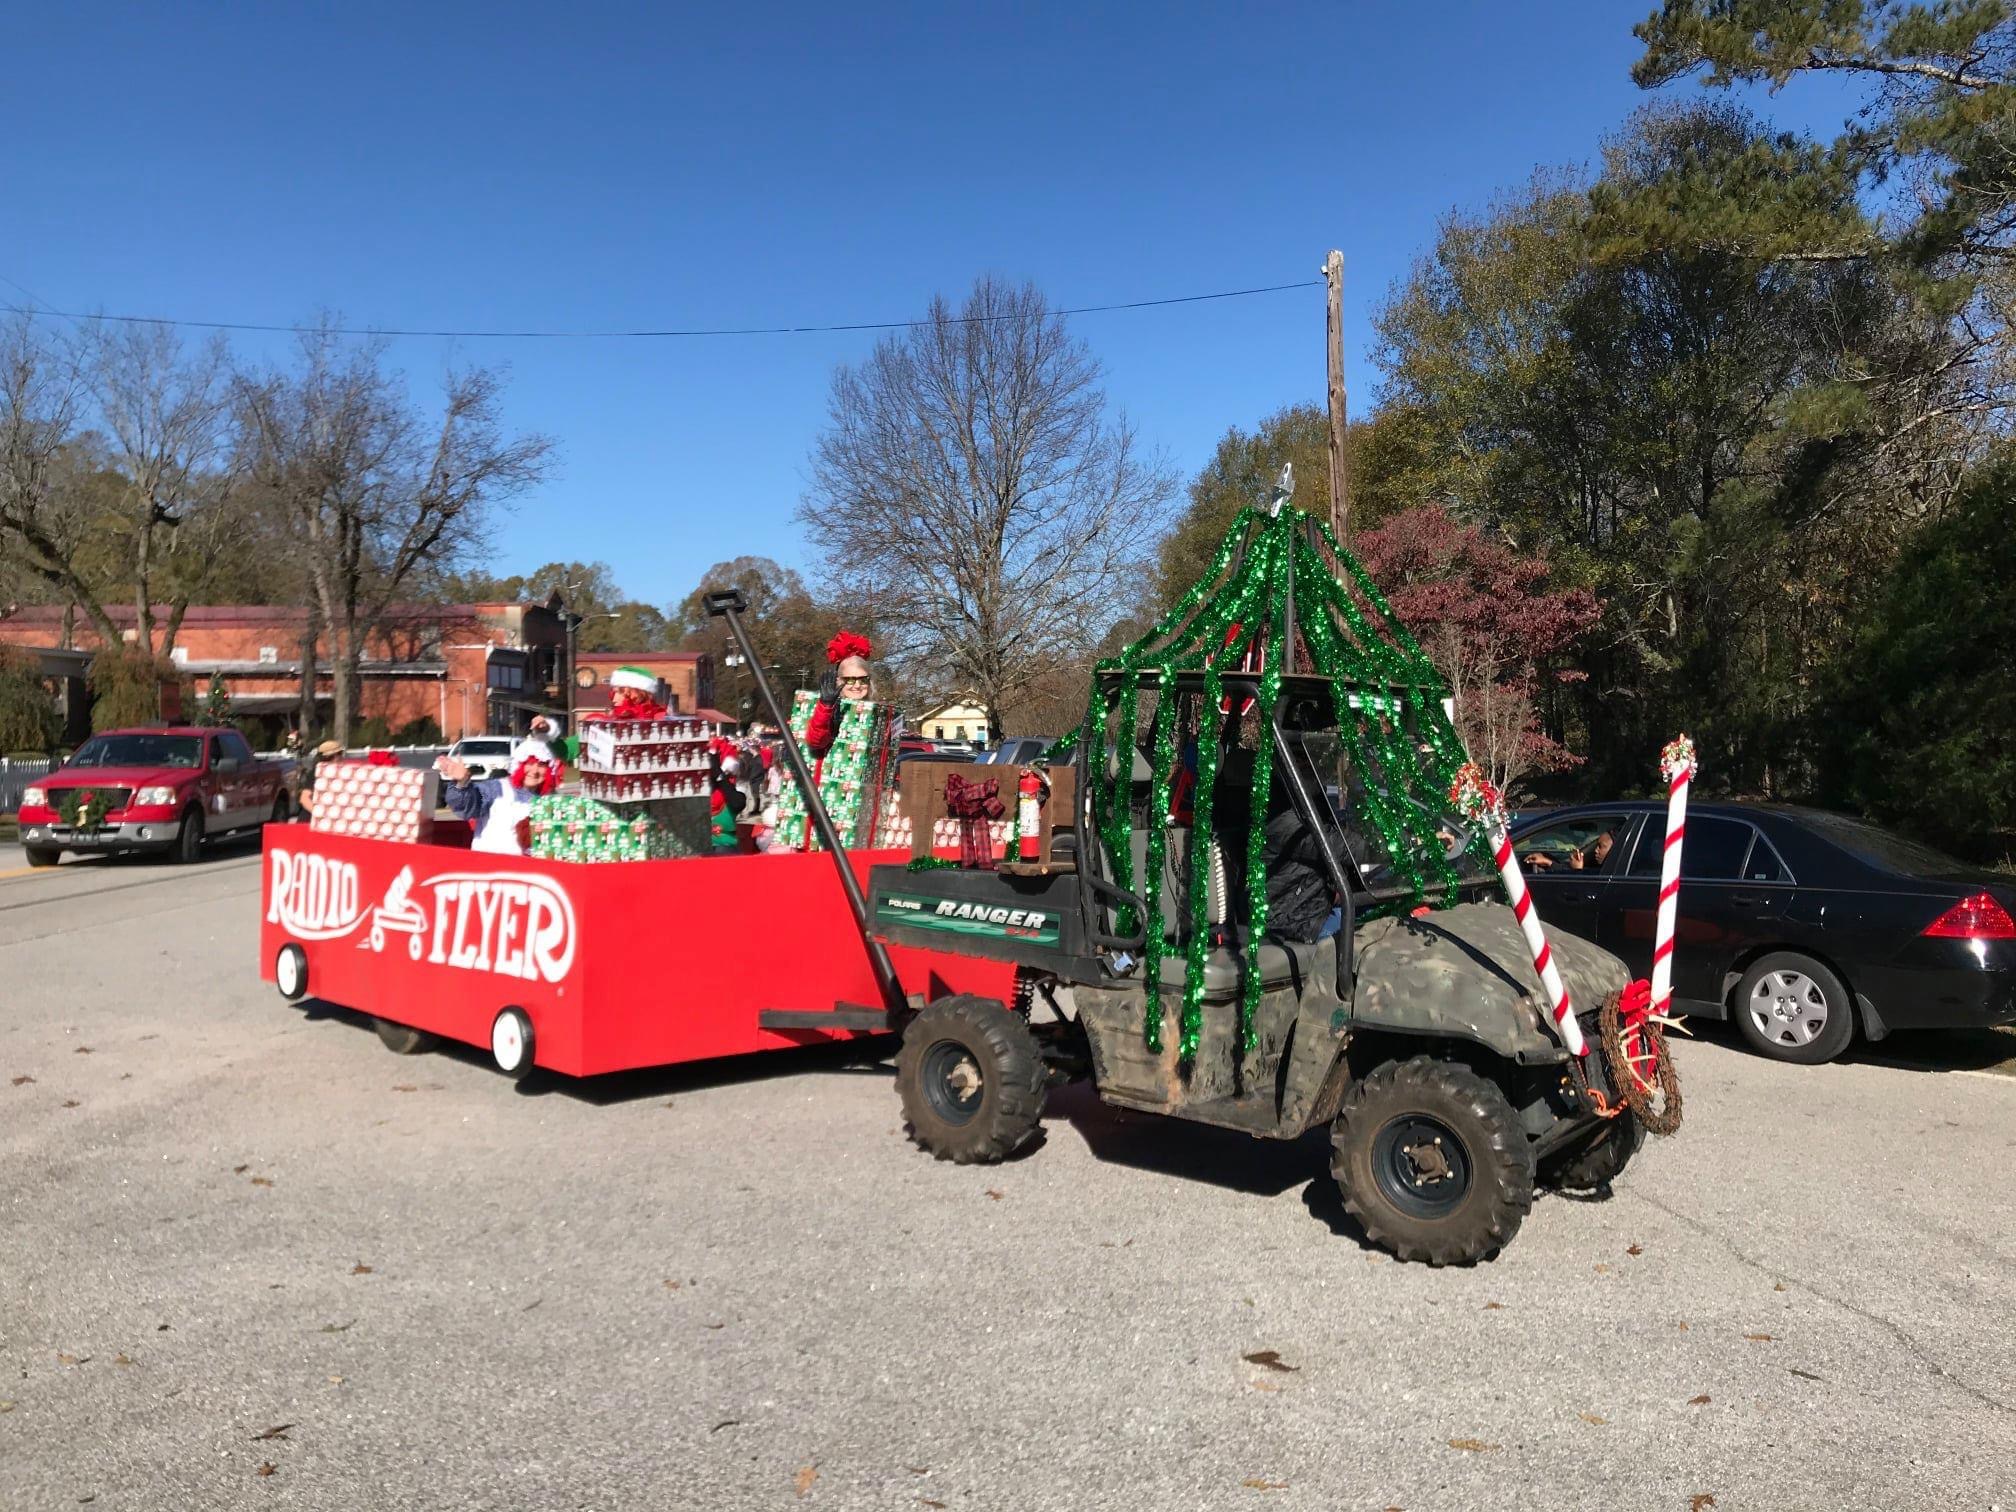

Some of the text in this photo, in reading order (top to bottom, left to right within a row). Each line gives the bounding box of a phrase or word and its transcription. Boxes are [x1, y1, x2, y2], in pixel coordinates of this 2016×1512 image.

[267, 848, 577, 983] RADIO FLYER
[936, 900, 1046, 929] RANGER
